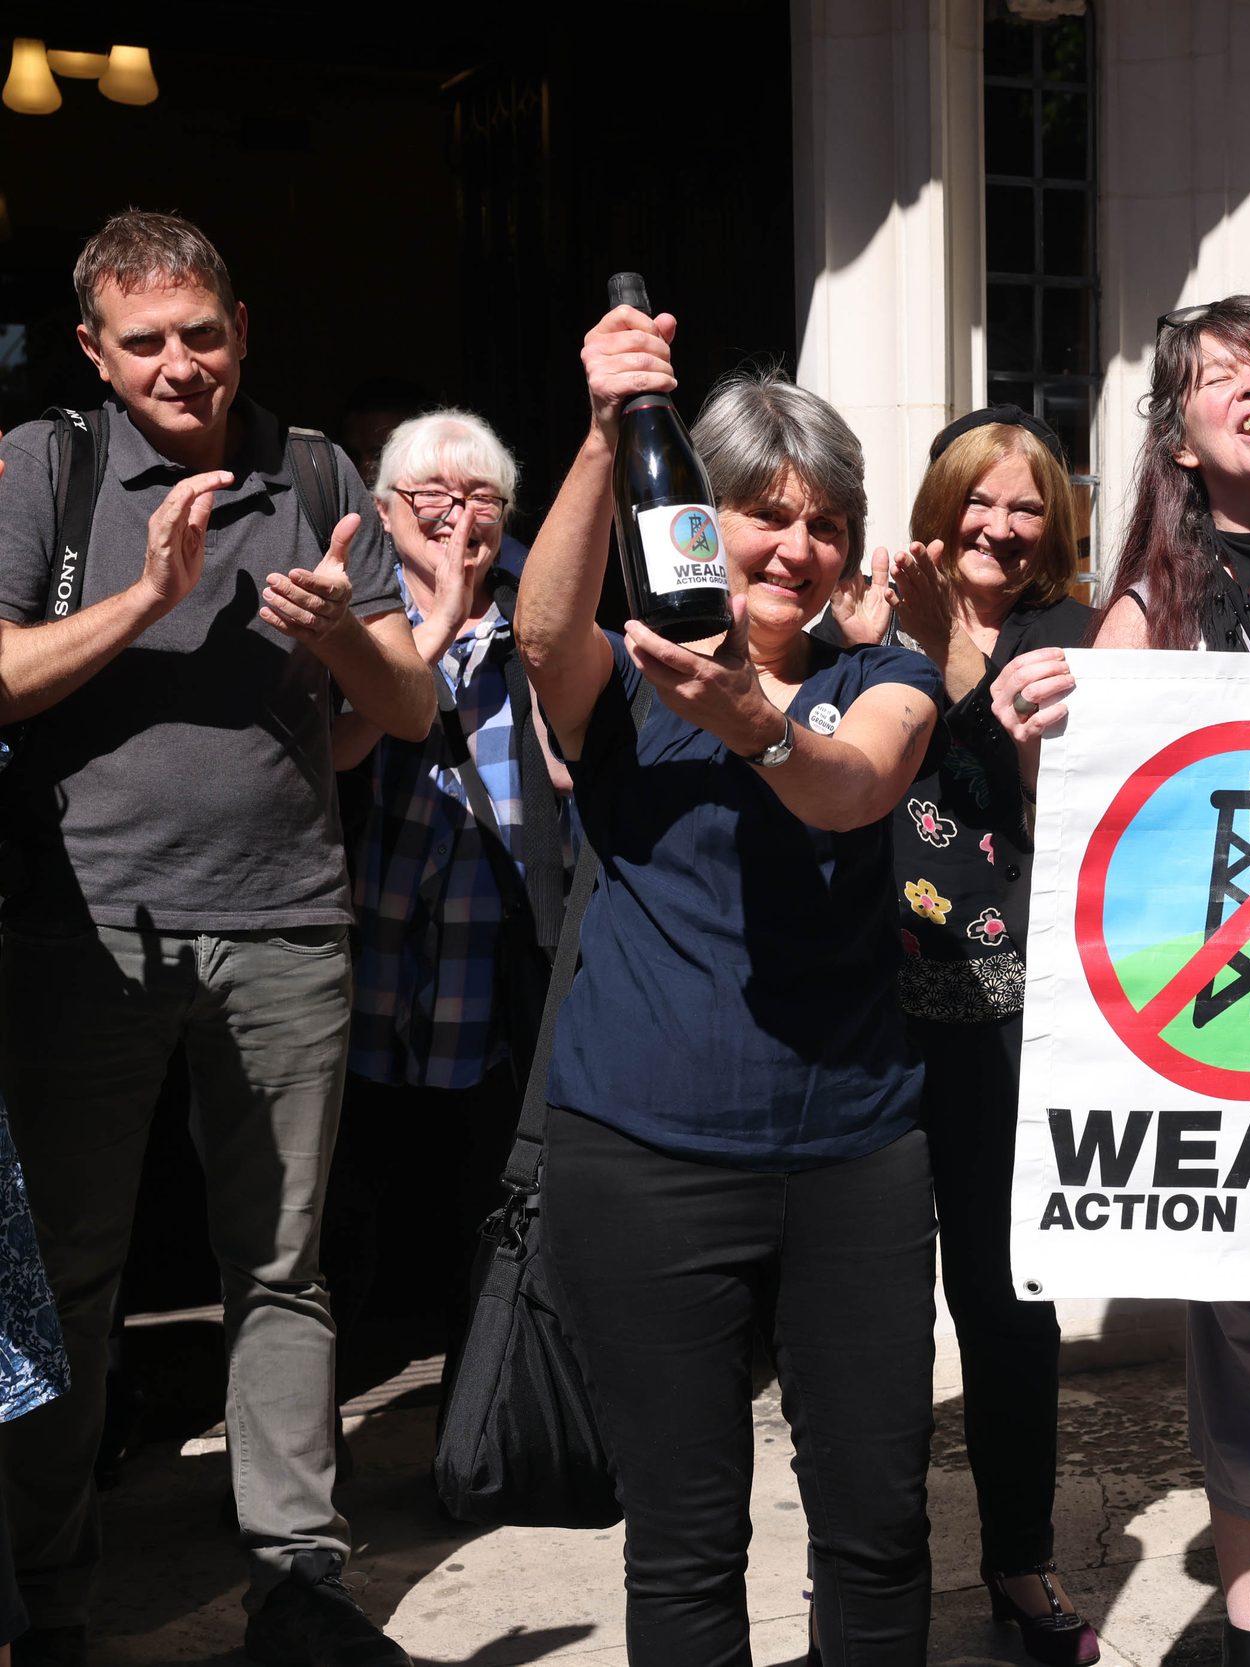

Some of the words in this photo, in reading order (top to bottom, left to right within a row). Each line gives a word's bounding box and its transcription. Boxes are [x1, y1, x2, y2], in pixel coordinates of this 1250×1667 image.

[673, 563, 727, 578] WEALD
[55, 545, 78, 616] SONY
[676, 577, 708, 585] ACTION
[811, 715, 835, 731] GROUND
[1039, 1192, 1238, 1232] ACTION
